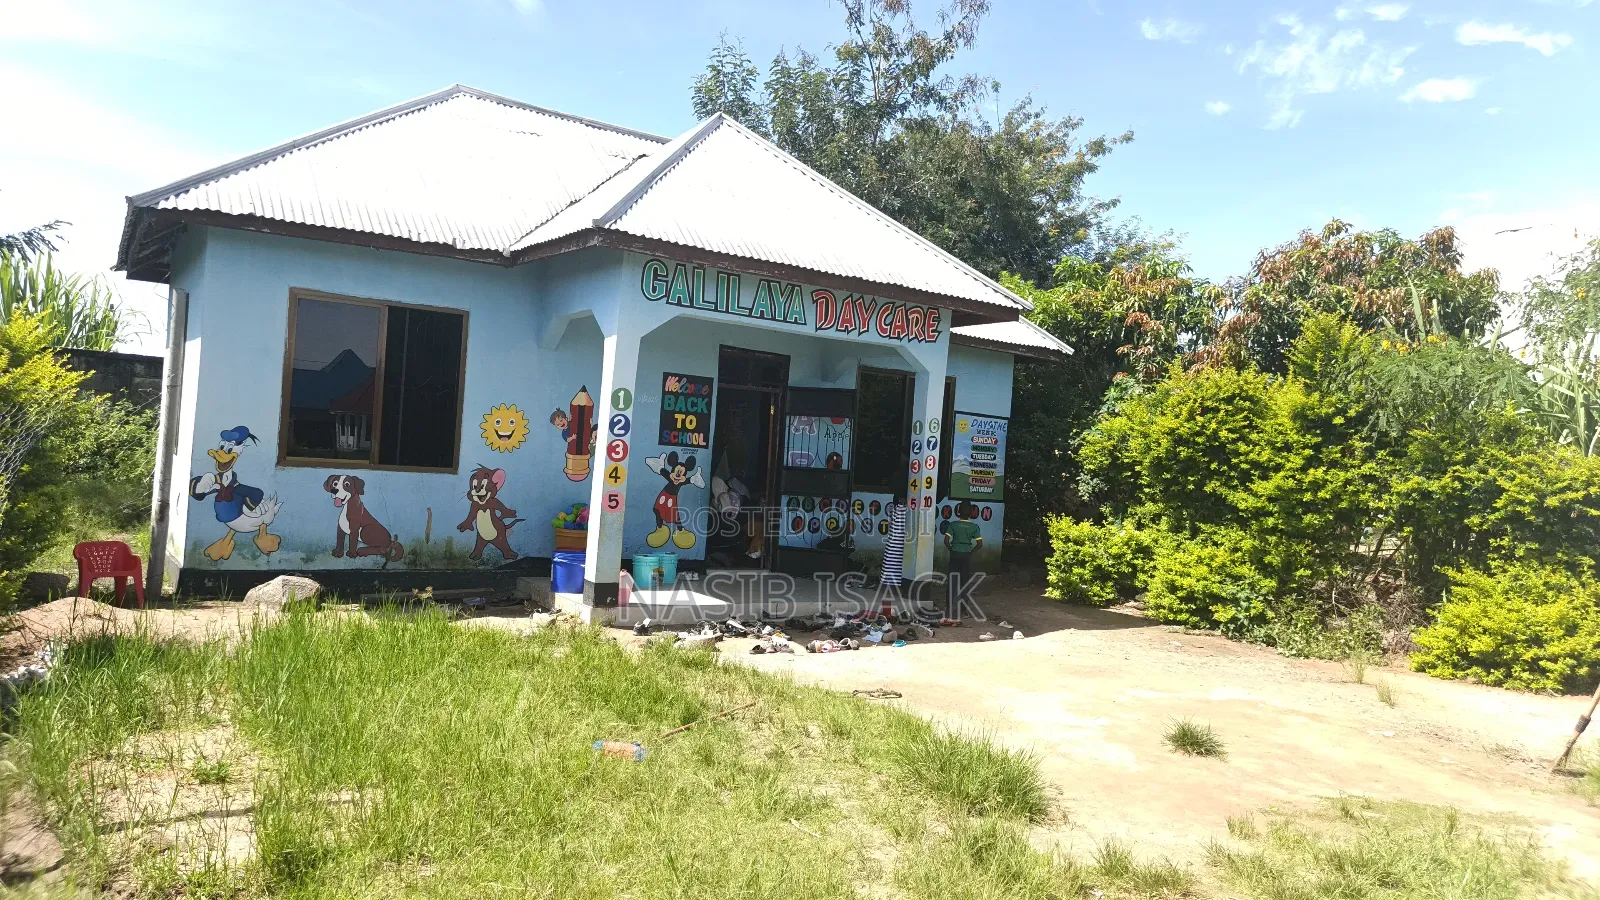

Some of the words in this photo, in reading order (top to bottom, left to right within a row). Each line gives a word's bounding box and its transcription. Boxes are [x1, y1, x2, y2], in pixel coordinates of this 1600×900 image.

[641, 258, 807, 326] GALILAYA
[664, 375, 710, 395] Welcome
[617, 390, 625, 409] 1
[664, 394, 708, 413] BACK
[613, 416, 626, 435] 2
[674, 413, 697, 430] TO
[662, 429, 707, 446] SCHOOL
[972, 436, 997, 445] SUNDAY
[611, 440, 624, 459] 3
[972, 445, 995, 453] MONDAY
[972, 453, 995, 461] TUESDAY
[969, 461, 997, 469] WEDNESDAY
[971, 469, 995, 477] THURSDAY
[608, 466, 621, 484] 4
[969, 485, 994, 493] SATURDAY
[607, 494, 620, 510] 5
